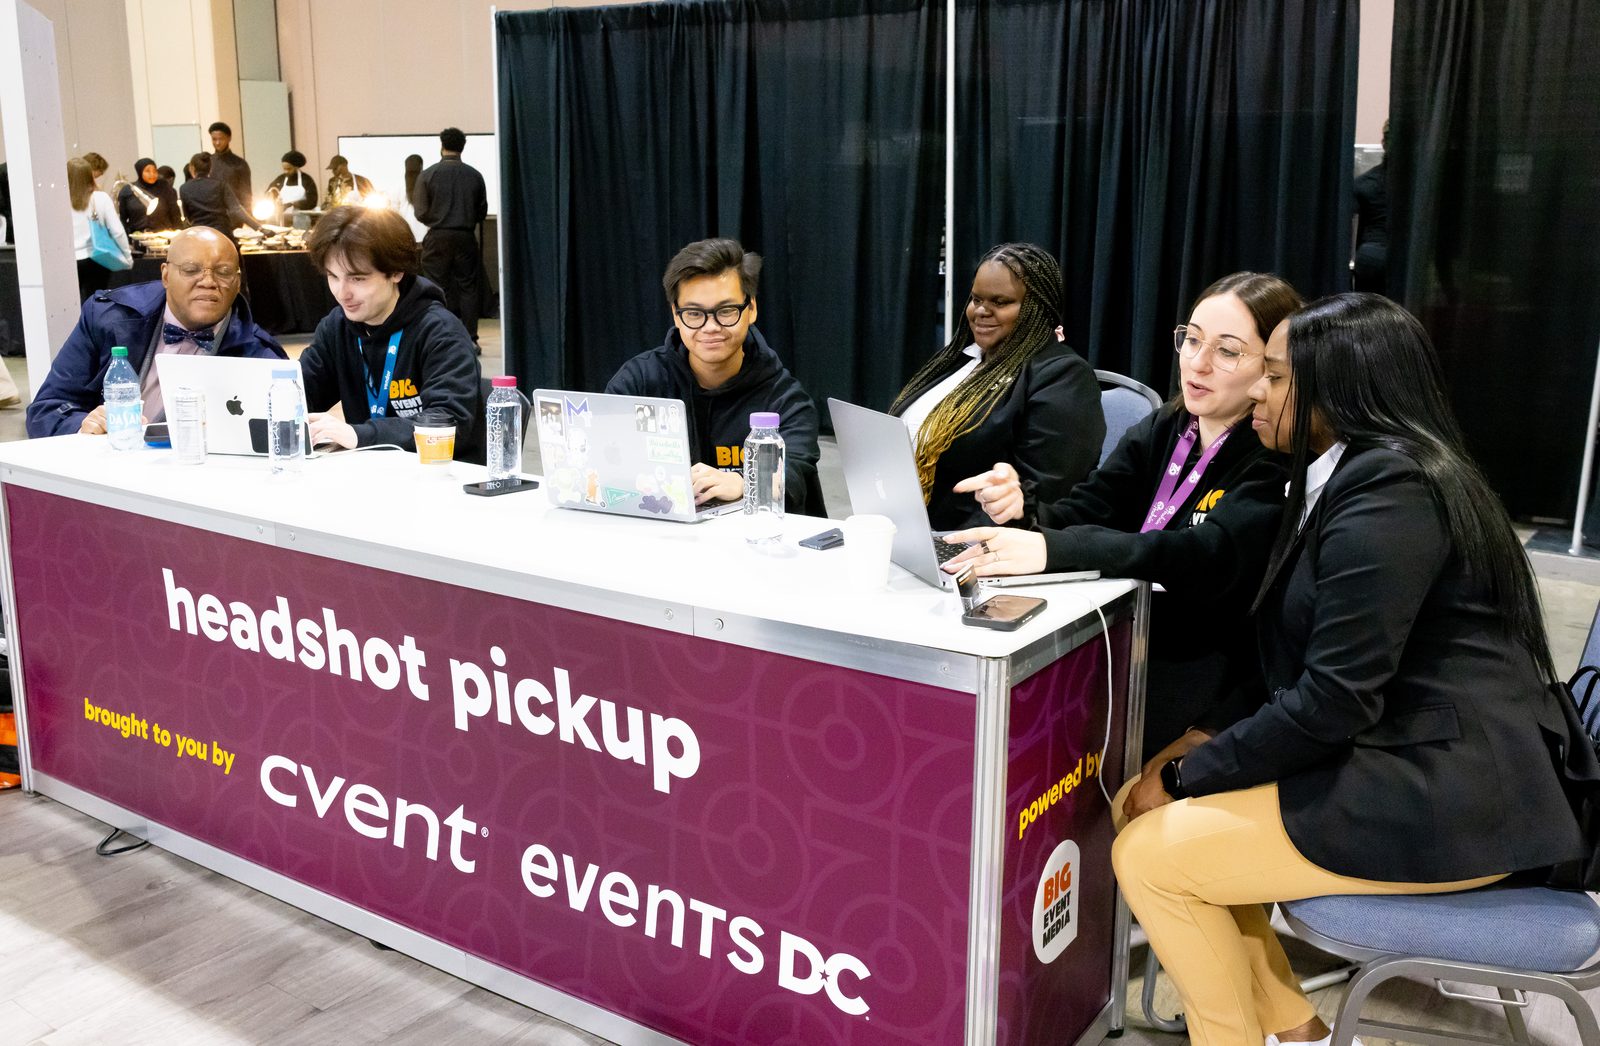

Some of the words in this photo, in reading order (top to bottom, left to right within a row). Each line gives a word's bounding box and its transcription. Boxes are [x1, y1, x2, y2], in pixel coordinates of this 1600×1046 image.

[389, 378, 418, 399] BIG
[390, 396, 423, 410] EVENT
[162, 567, 430, 701] headshot
[449, 645, 701, 794] pickup
[84, 697, 148, 739] brought
[153, 723, 171, 747] to
[175, 733, 207, 760] you
[212, 741, 235, 775] by
[1018, 757, 1082, 840] powered
[1086, 750, 1104, 778] by
[1043, 862, 1072, 910] BIG
[1042, 914, 1070, 949] MEDIA
[1043, 890, 1071, 930] EVENT
